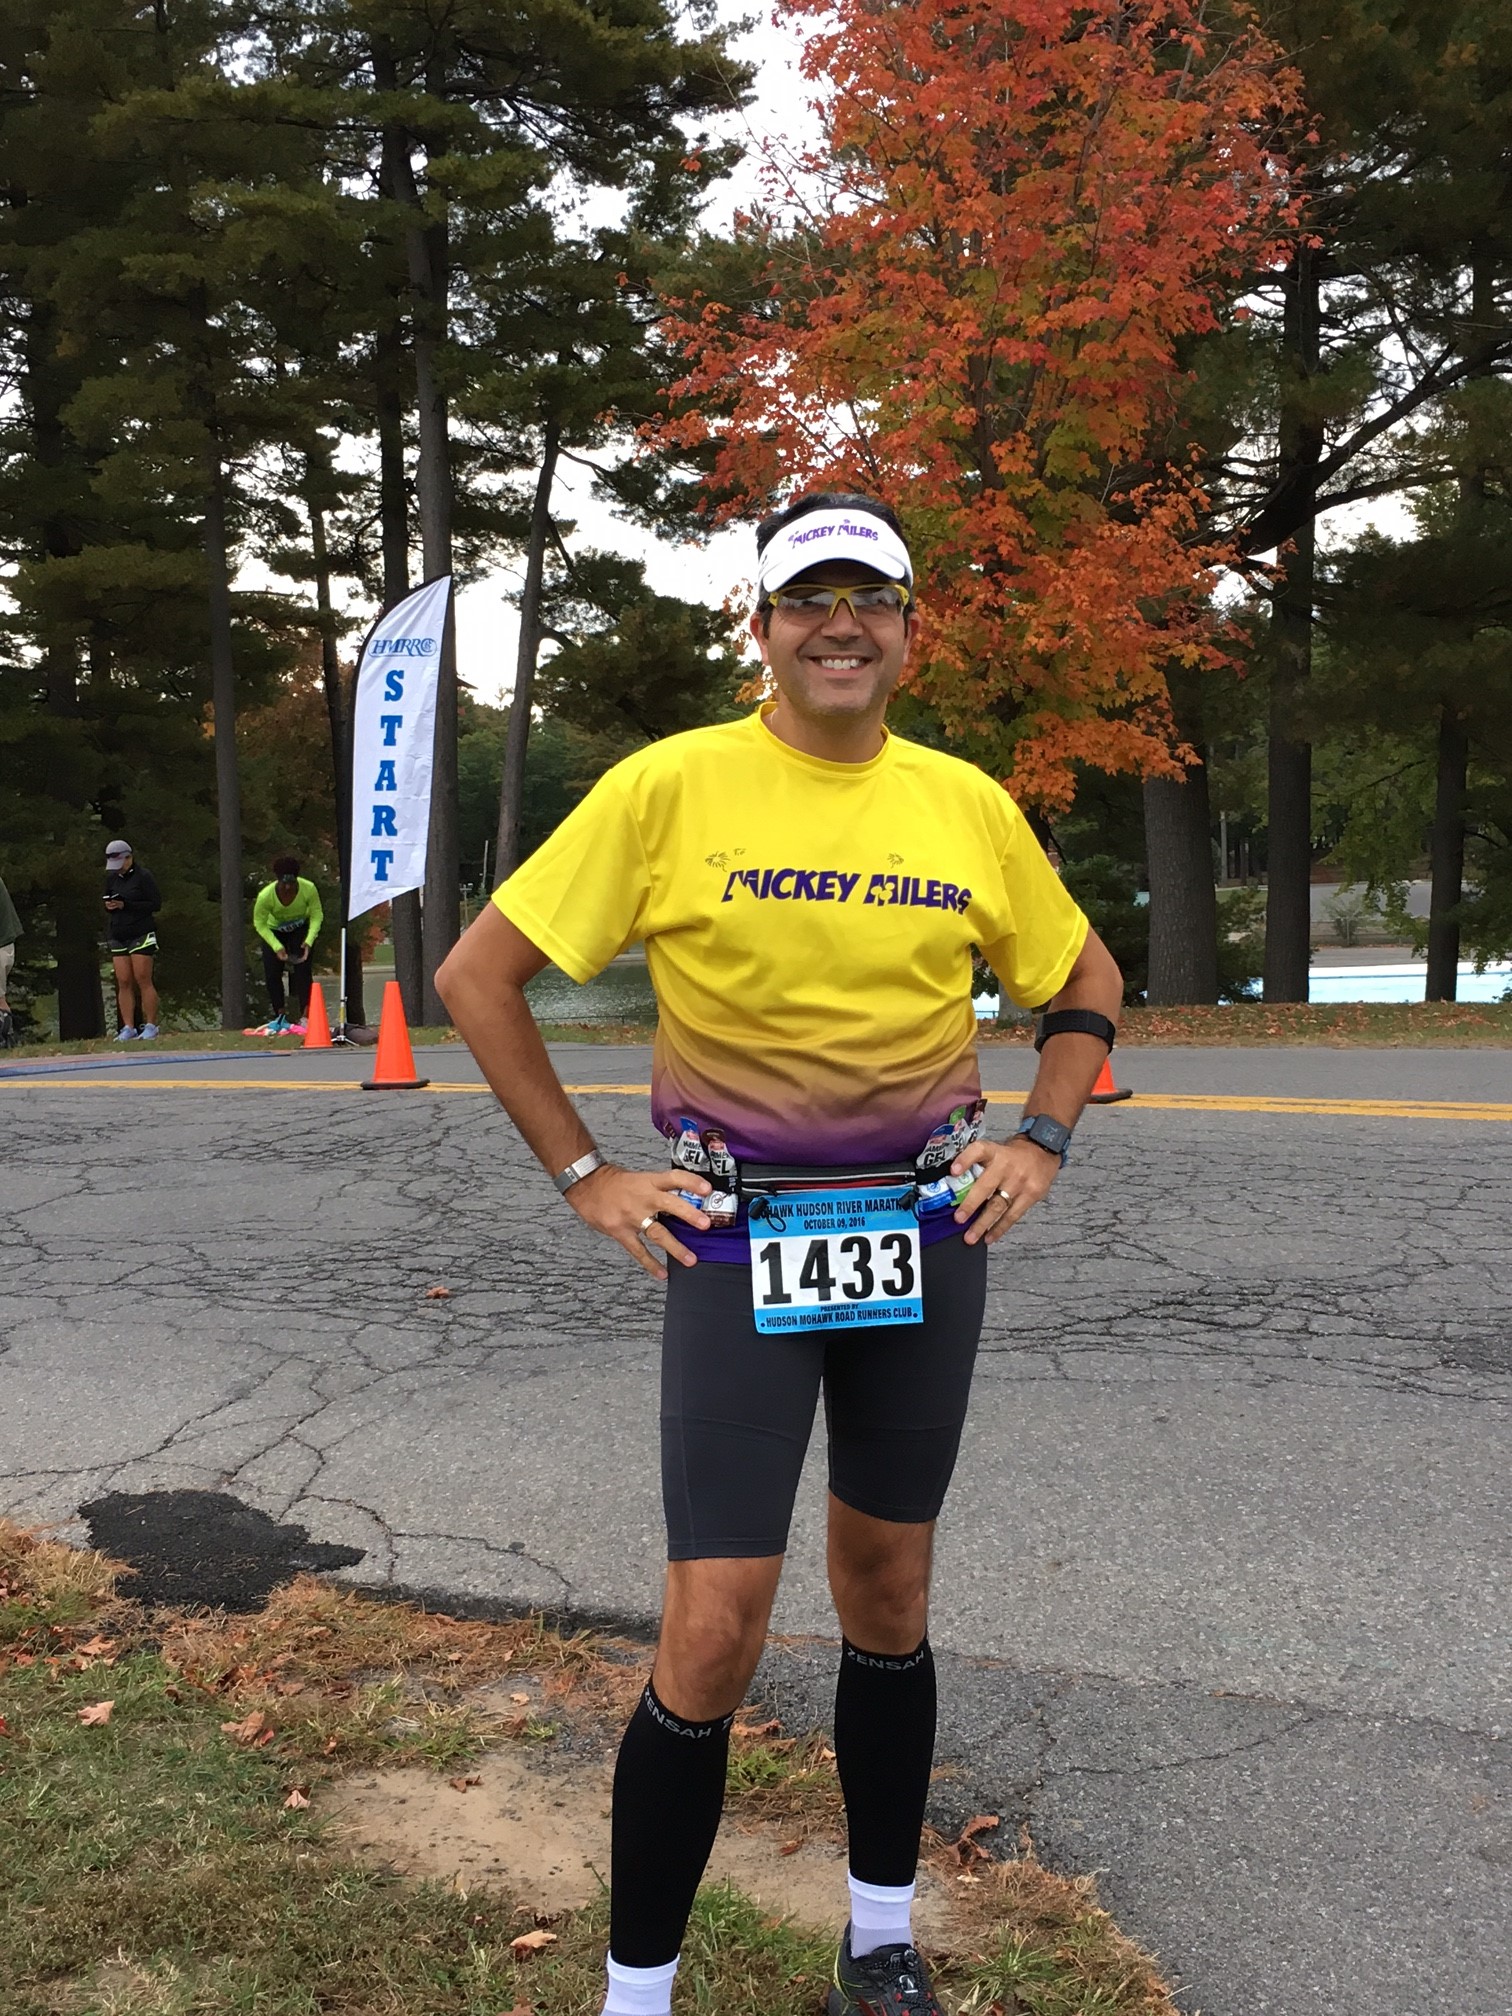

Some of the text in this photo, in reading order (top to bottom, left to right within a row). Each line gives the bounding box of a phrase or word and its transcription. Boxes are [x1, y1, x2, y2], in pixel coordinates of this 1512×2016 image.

[791, 524, 879, 549] MICKEY MILERS
[370, 669, 405, 882] START
[721, 868, 972, 916] MICKEY MILERS
[760, 1197, 903, 1219] OHAWK HUDSON RIVER MARATH
[804, 1217, 836, 1230] OCTOBER
[848, 1216, 866, 1228] 2016
[760, 1233, 915, 1305] 1433
[766, 1306, 913, 1328] HUDSON MOHAWK ROAD RUNNERS CLUB
[820, 1304, 850, 1313] PRESENTED
[847, 1646, 925, 1671] ZENSAH
[644, 1686, 712, 1740] ZENSAH
